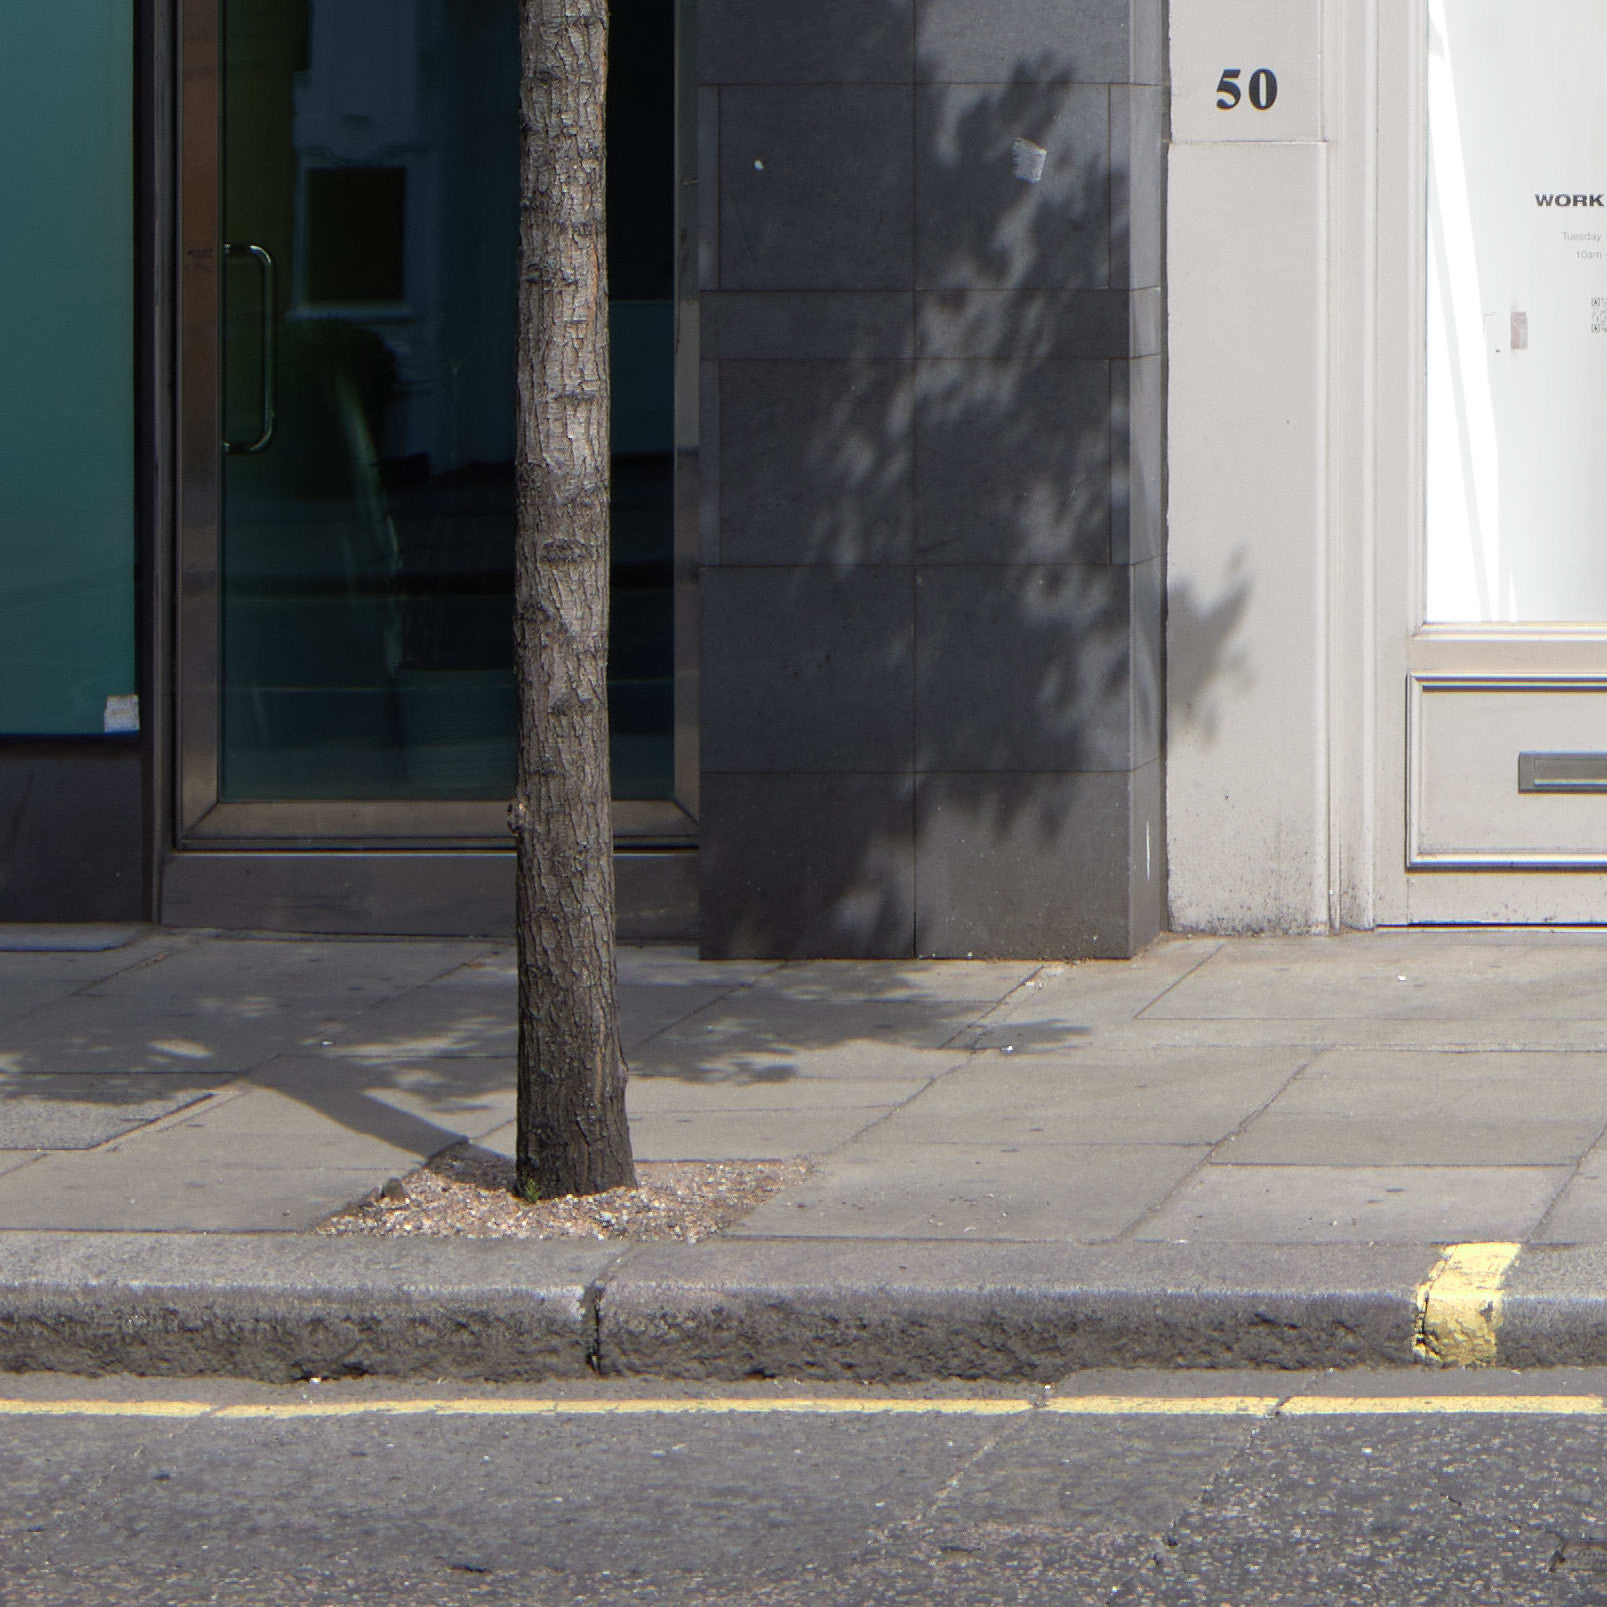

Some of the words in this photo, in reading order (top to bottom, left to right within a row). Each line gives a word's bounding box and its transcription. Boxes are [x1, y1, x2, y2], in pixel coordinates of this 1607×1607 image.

[1215, 67, 1279, 111] 50
[1562, 231, 1602, 242] Tuesday
[1576, 249, 1602, 260] 10am
